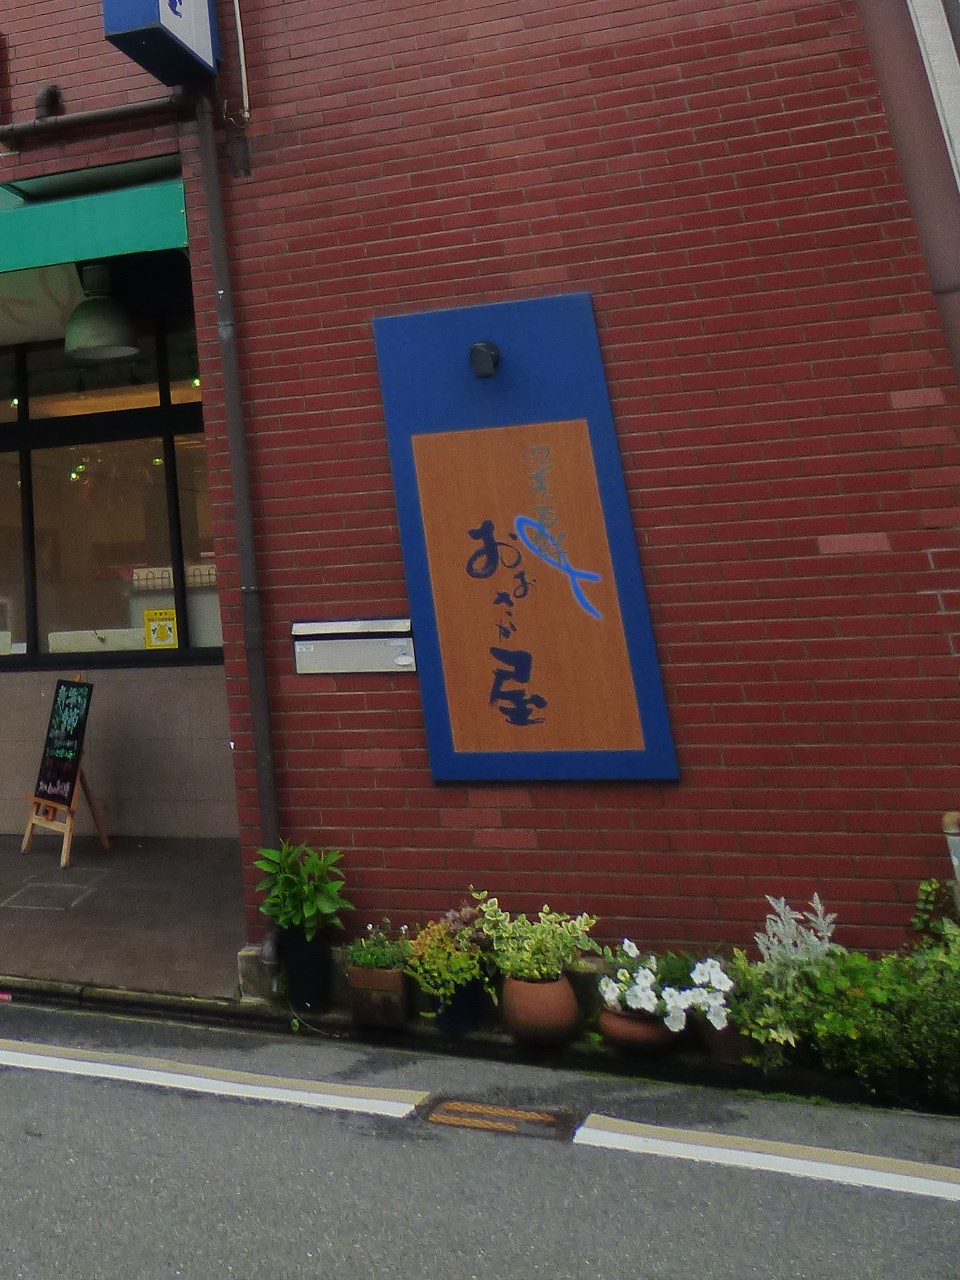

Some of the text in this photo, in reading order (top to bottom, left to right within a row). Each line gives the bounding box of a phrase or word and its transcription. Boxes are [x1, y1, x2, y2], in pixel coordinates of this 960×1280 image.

[466, 519, 548, 727] おおさか屋
